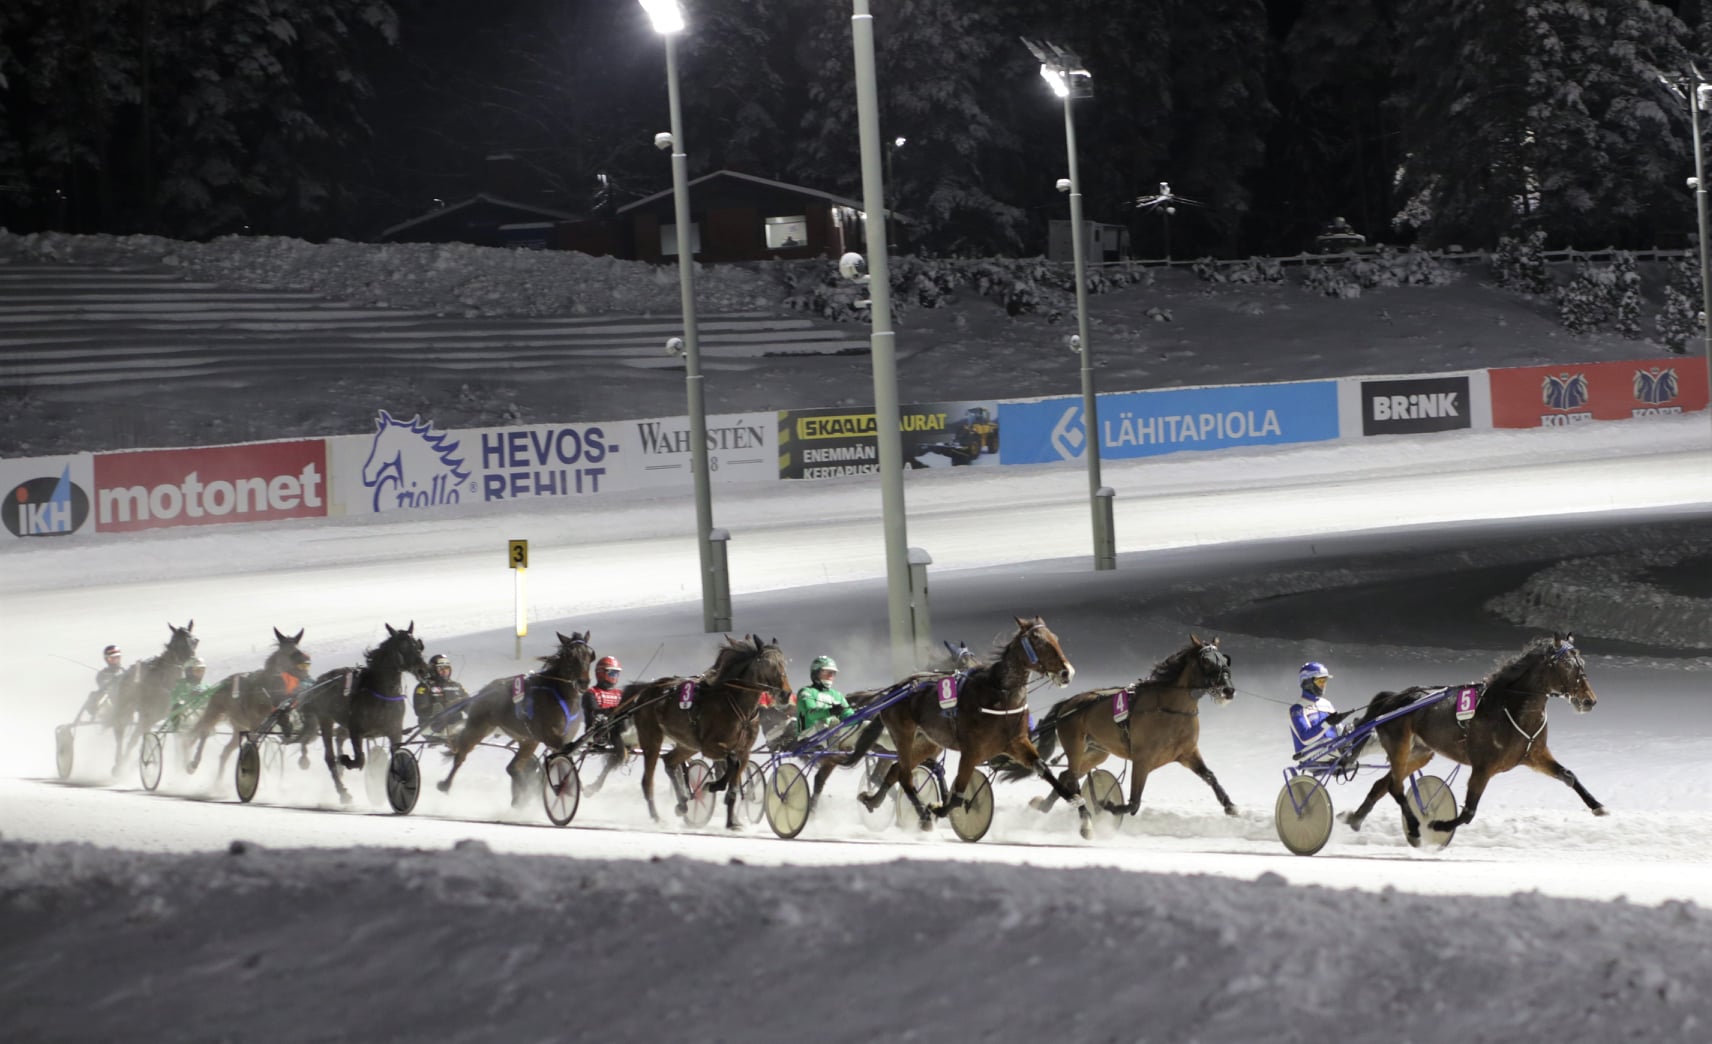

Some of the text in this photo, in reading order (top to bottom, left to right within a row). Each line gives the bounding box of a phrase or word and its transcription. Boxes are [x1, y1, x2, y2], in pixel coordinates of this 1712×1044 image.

[805, 417, 878, 436] SKAALA
[1104, 410, 1281, 447] LÄHITAPIOLA
[637, 419, 765, 455] WAHSTÉN
[482, 427, 620, 469] HEVOS-
[803, 444, 875, 463] ENEMMÄN
[803, 462, 913, 479] KERTAPUSKA
[99, 462, 322, 525] motonet
[513, 545, 524, 562] 3
[514, 677, 521, 695] 9
[683, 682, 692, 701] 3
[942, 678, 952, 699] 8
[1116, 692, 1124, 711] 4
[1460, 690, 1471, 711] 5
